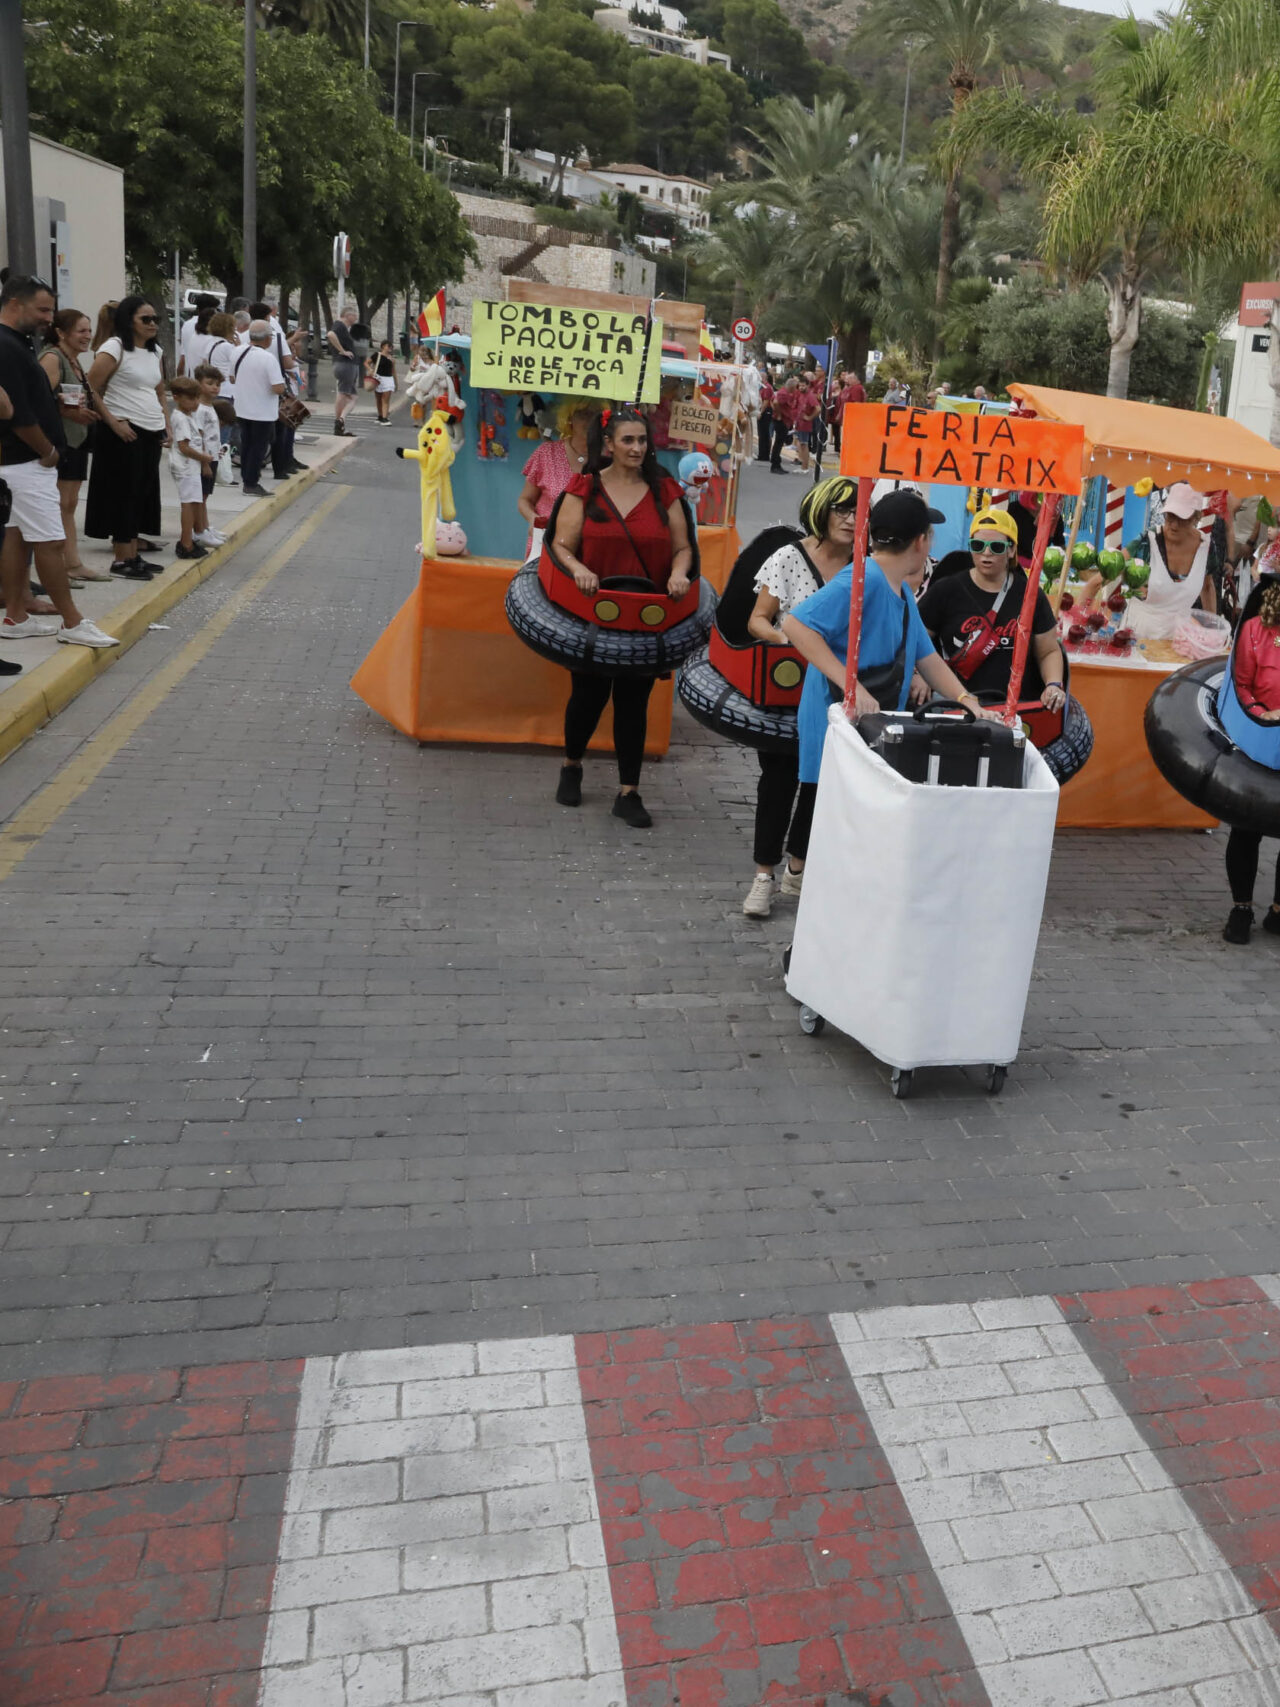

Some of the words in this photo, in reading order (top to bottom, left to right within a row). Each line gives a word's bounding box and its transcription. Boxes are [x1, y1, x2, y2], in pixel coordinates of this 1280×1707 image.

[482, 300, 647, 335] TOMBOLA
[737, 325, 750, 335] 30
[510, 355, 536, 369] NO
[541, 356, 564, 370] LE
[572, 357, 624, 375] TOCA
[681, 406, 715, 421] BOLETO
[680, 420, 711, 435] PESETA
[885, 405, 1016, 447] FERIA
[879, 442, 1057, 488] LIATRIX
